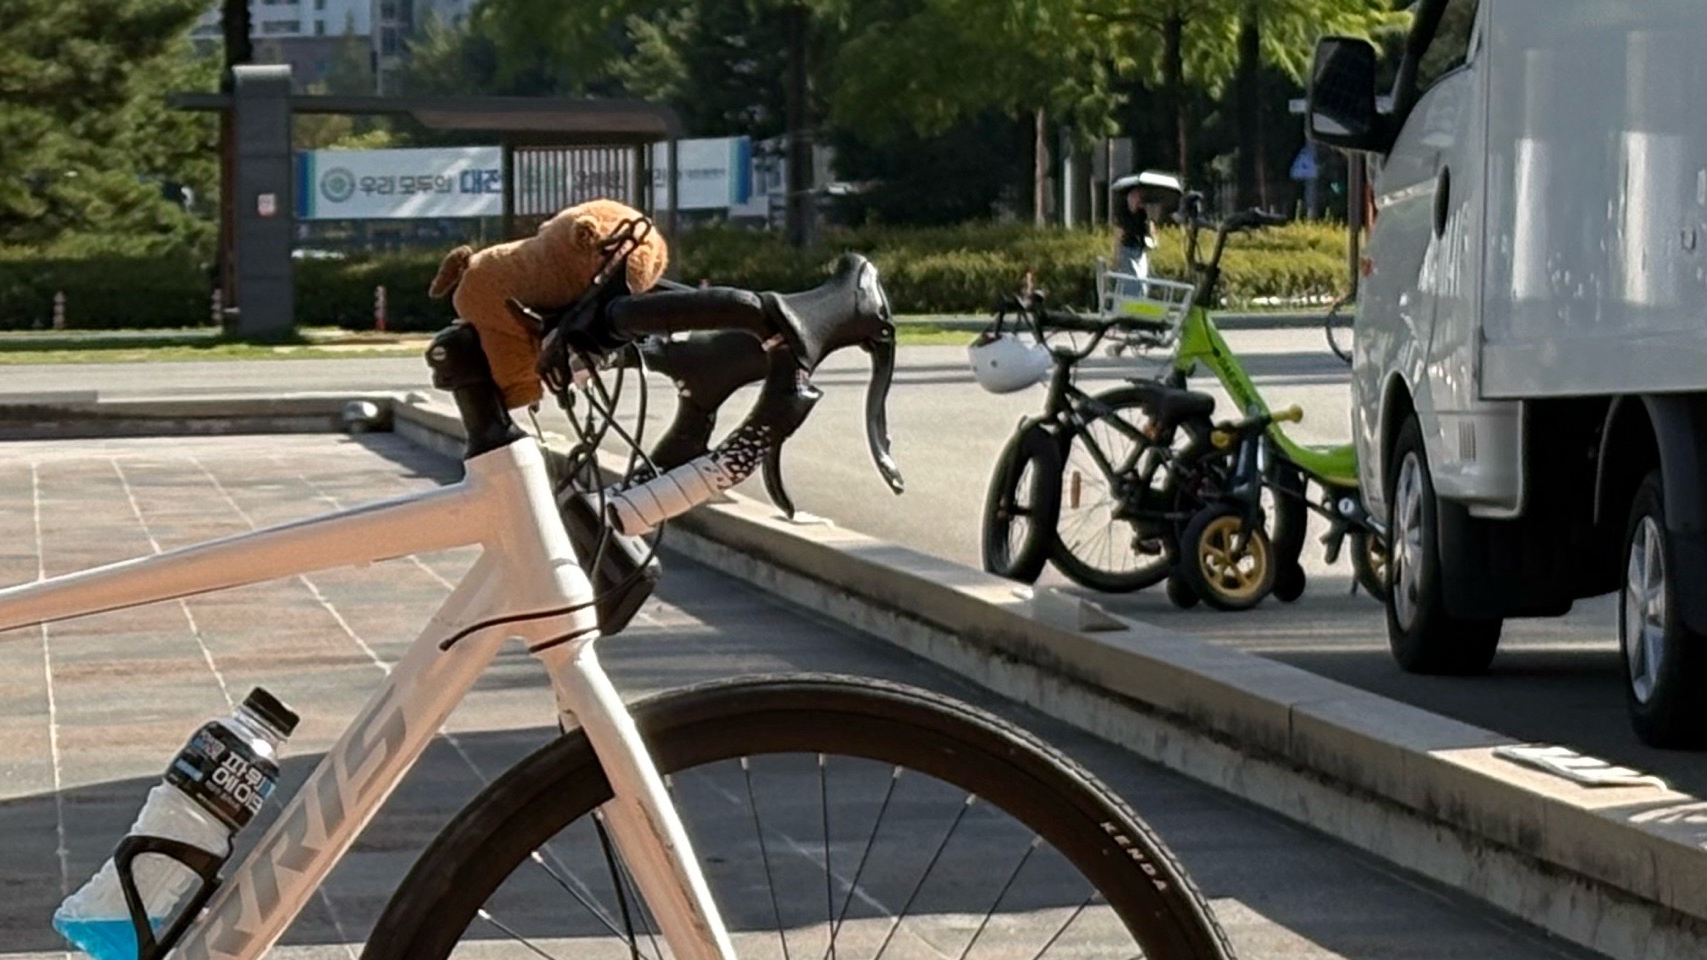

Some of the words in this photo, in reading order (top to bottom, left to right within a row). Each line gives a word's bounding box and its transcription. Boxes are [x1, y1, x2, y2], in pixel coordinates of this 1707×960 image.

[359, 175, 395, 196] 우리
[398, 174, 452, 194] 모두의
[211, 767, 264, 815] 에이드
[221, 751, 269, 791] 파워
[1100, 822, 1167, 891] KENDA
